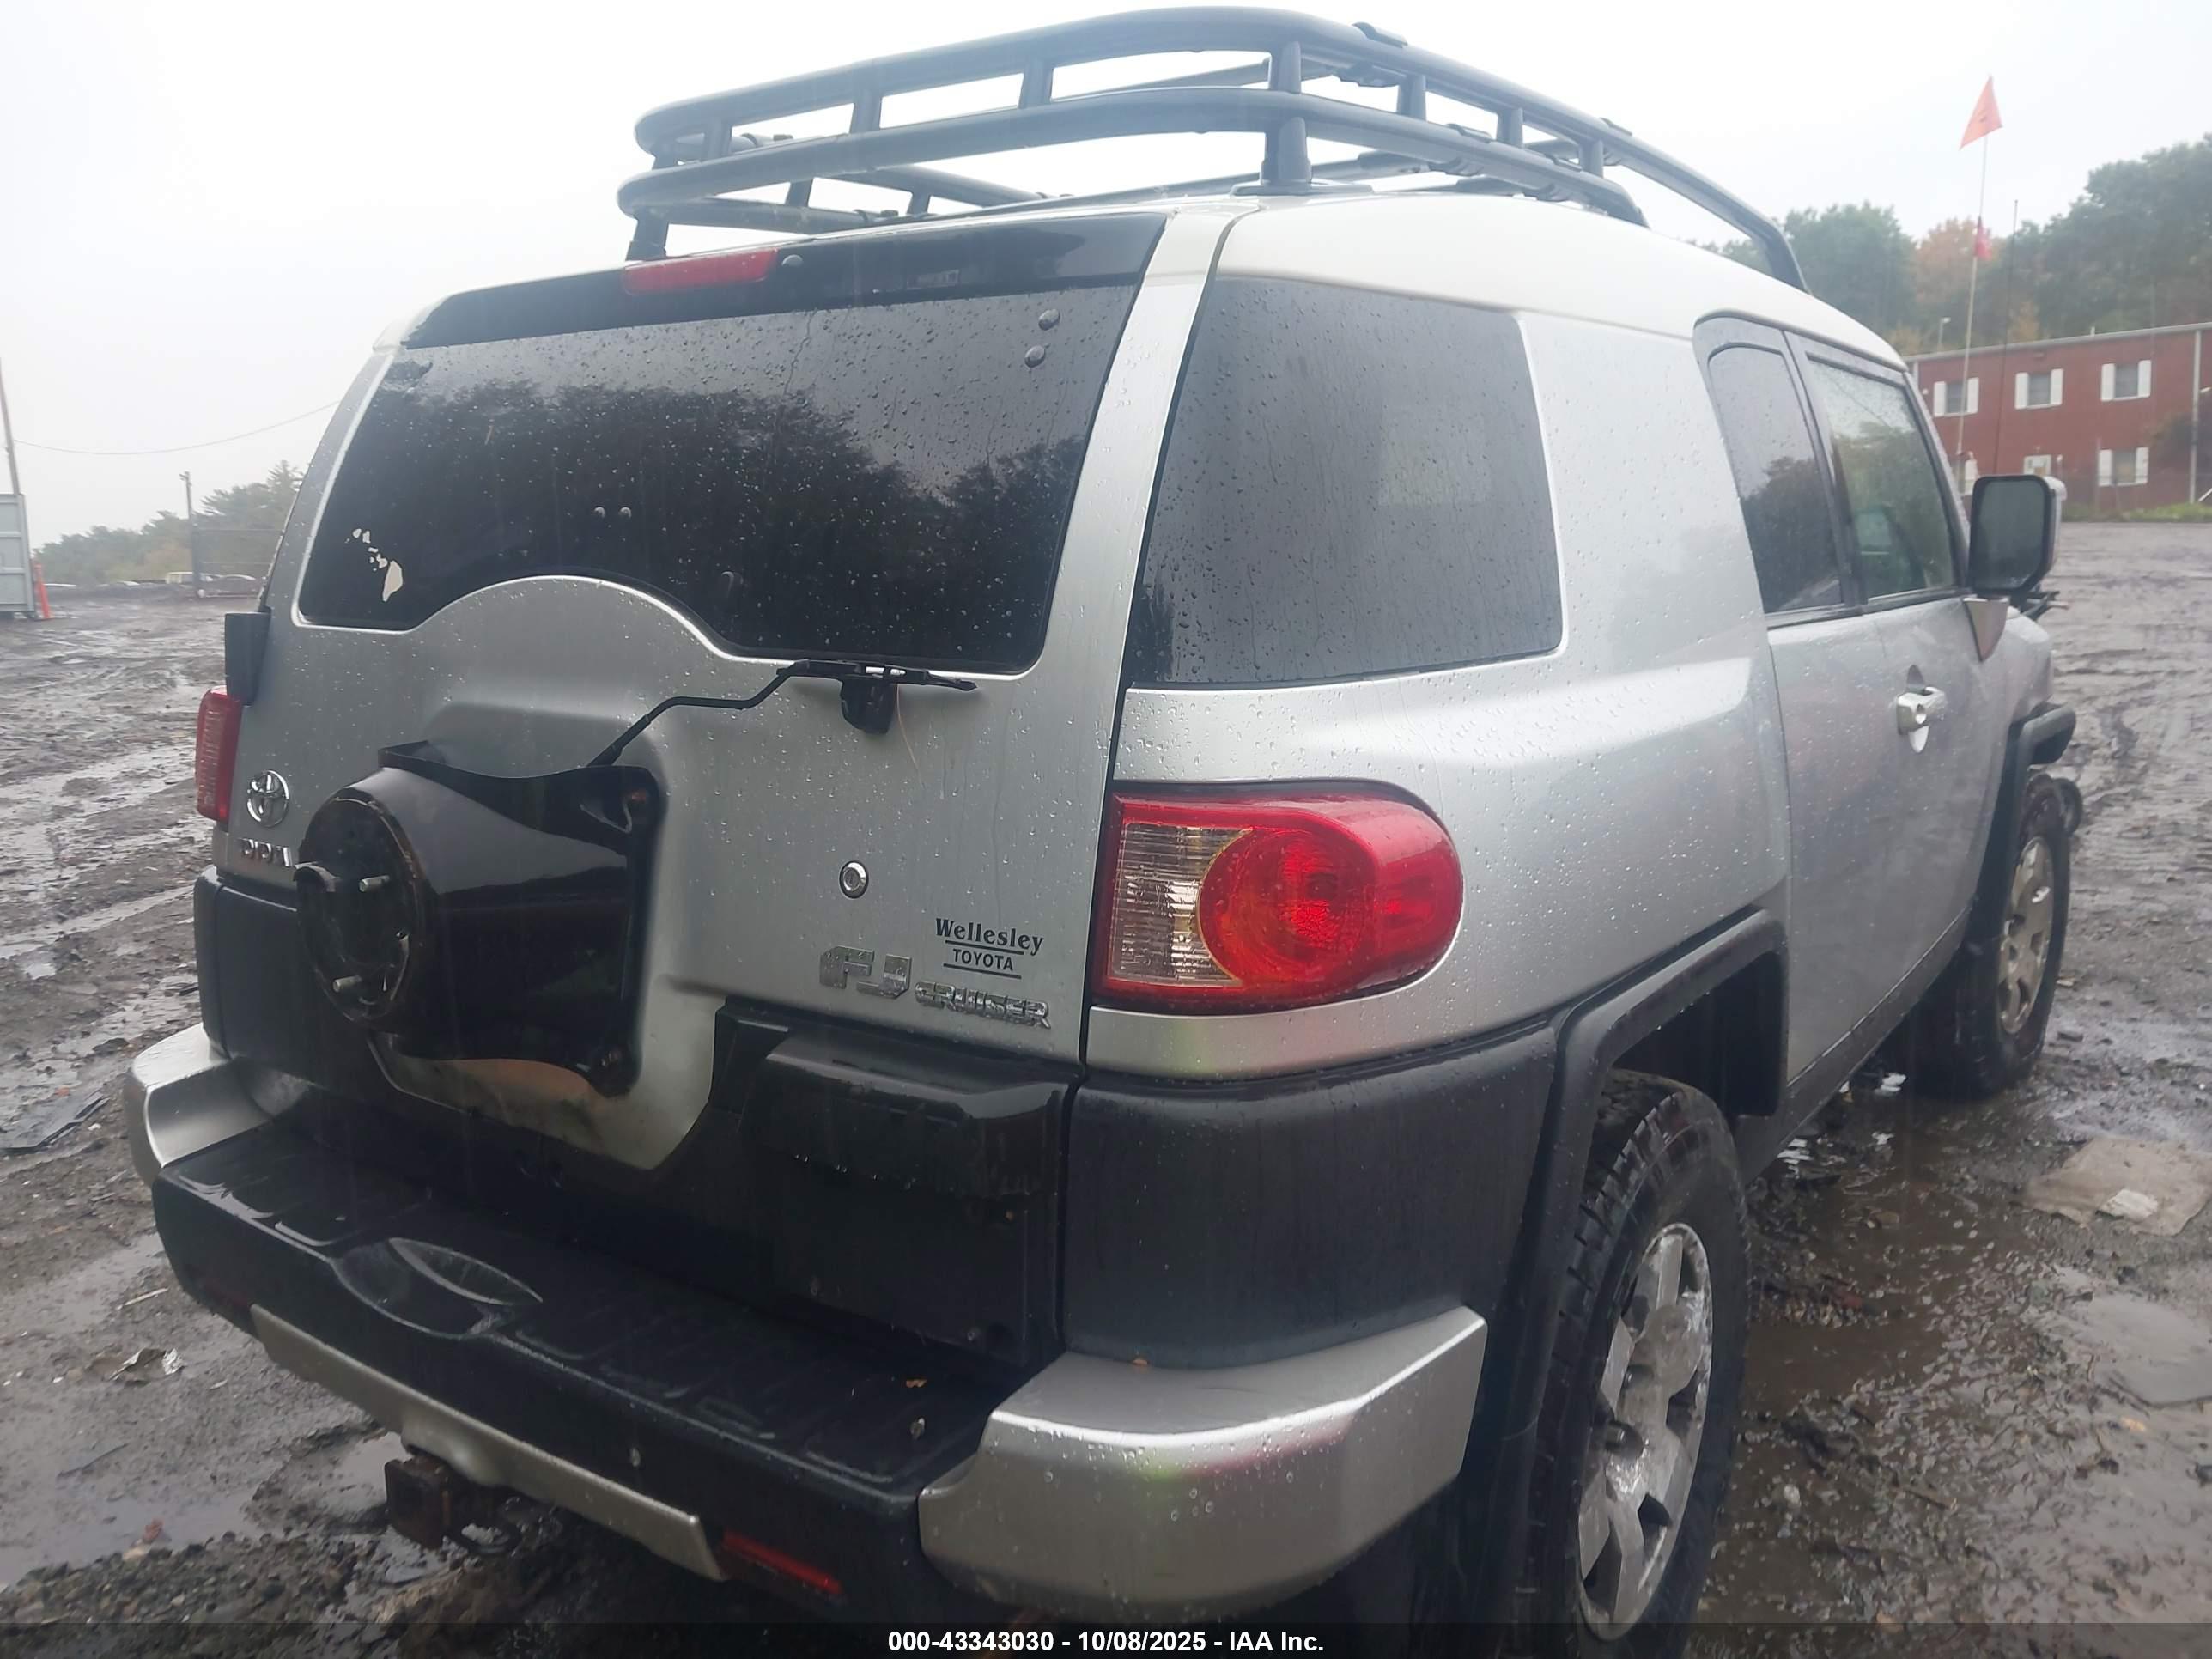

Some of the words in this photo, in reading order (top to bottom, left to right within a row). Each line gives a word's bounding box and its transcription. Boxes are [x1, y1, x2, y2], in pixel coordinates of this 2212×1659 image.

[935, 917, 1044, 957] Wellesley
[952, 948, 1014, 972] TOYOTA
[819, 945, 912, 1000] FJ
[915, 981, 1052, 1030] CRUISER
